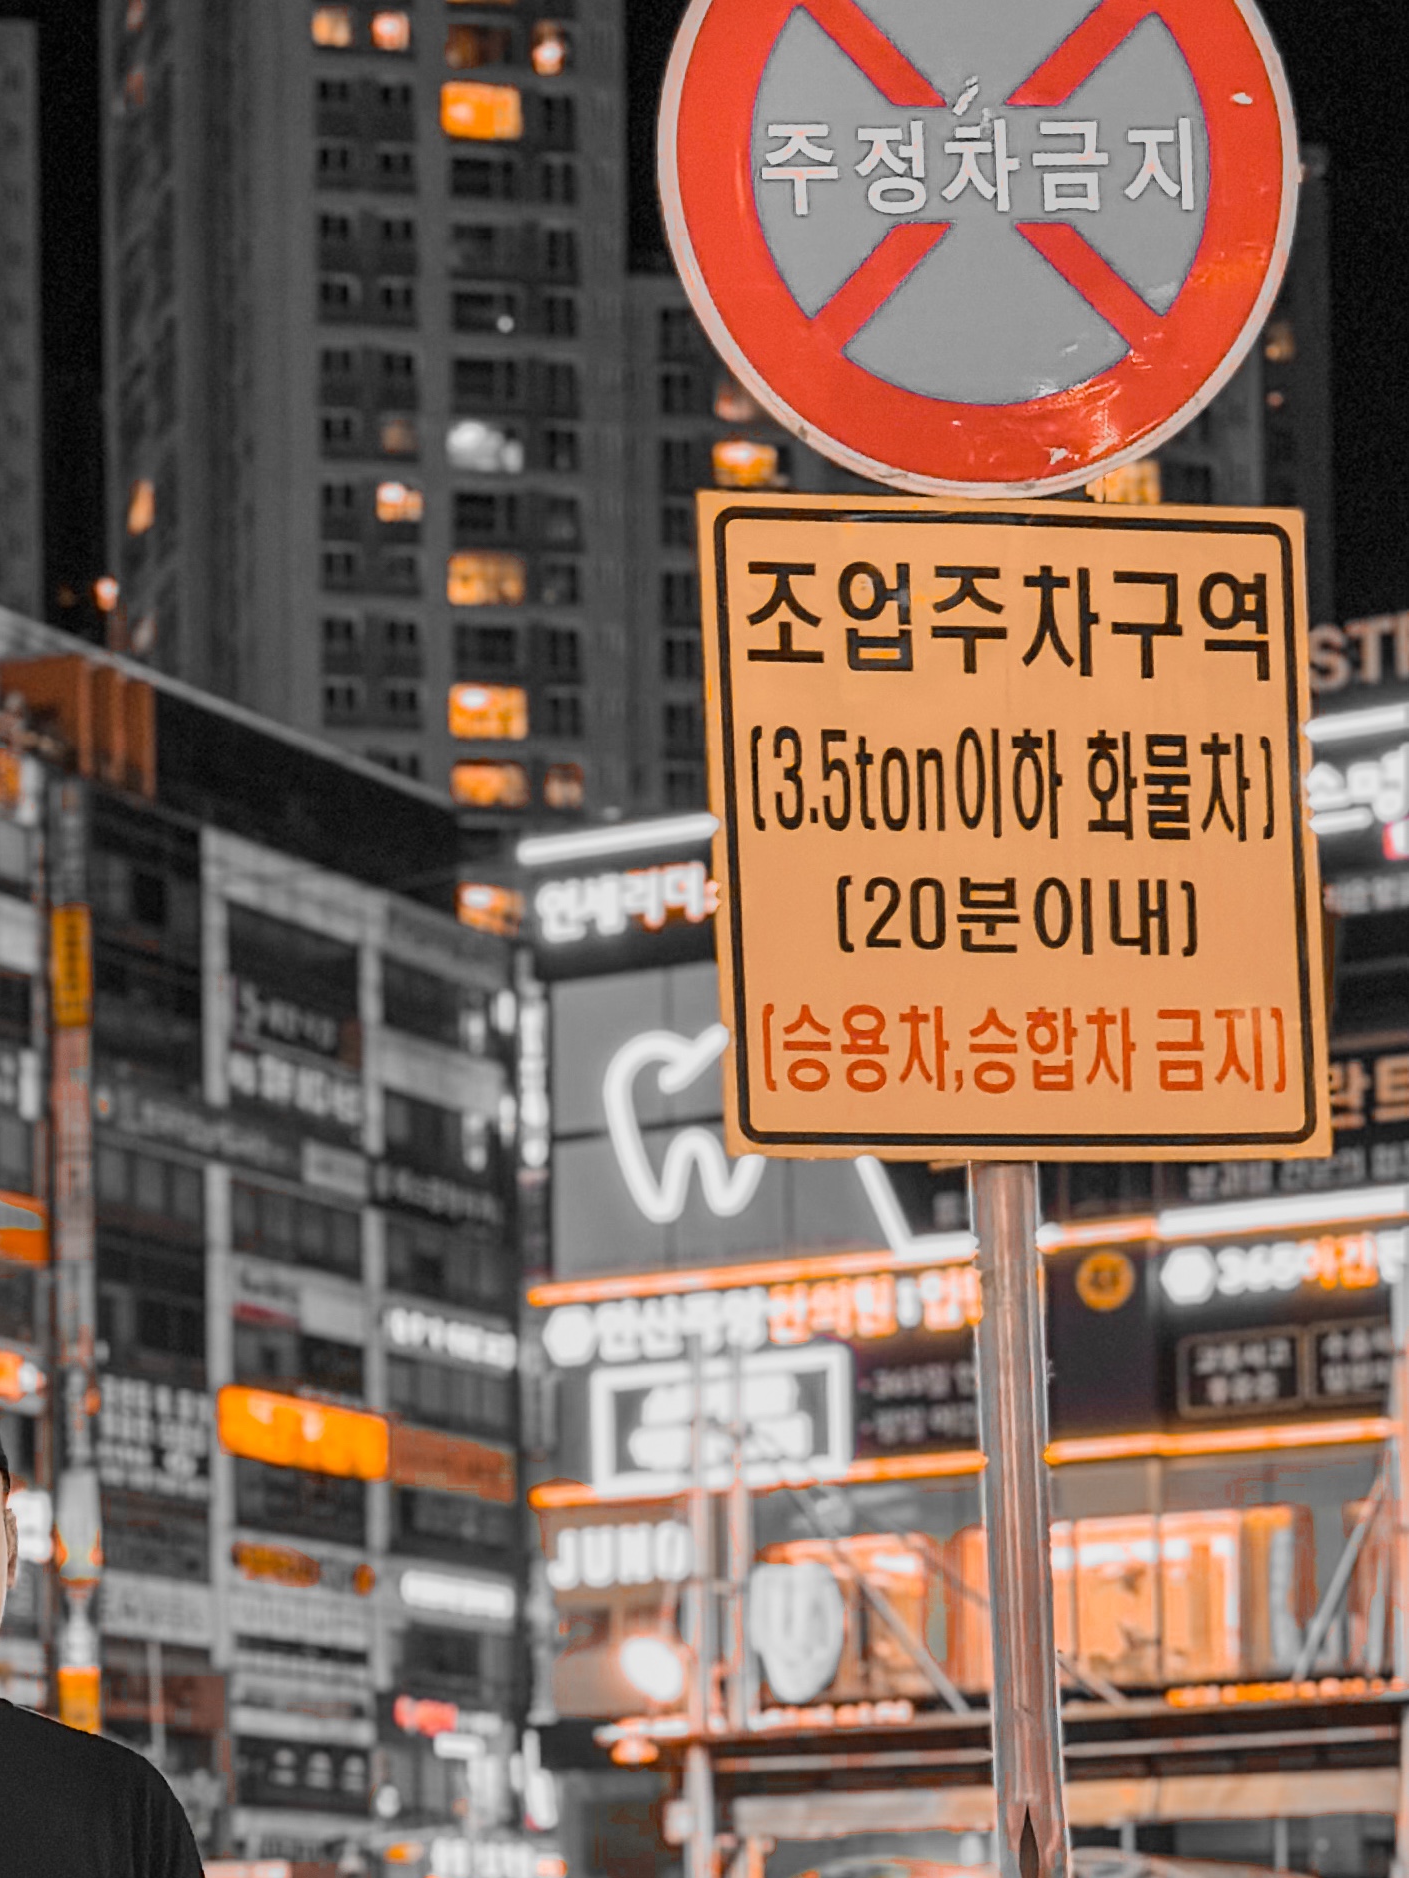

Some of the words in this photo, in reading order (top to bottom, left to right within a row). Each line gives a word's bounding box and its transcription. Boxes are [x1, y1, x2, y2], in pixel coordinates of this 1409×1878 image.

[760, 111, 1195, 215] 주정차금지
[745, 560, 1272, 681] 조업주차구역
[751, 725, 1064, 840] (3.5ton이하
[1087, 729, 1276, 843] 화물차)
[837, 875, 1198, 958] (20분이내)
[762, 1002, 1136, 1094] (승용차,승합차
[1156, 1006, 1288, 1094] 금지)
